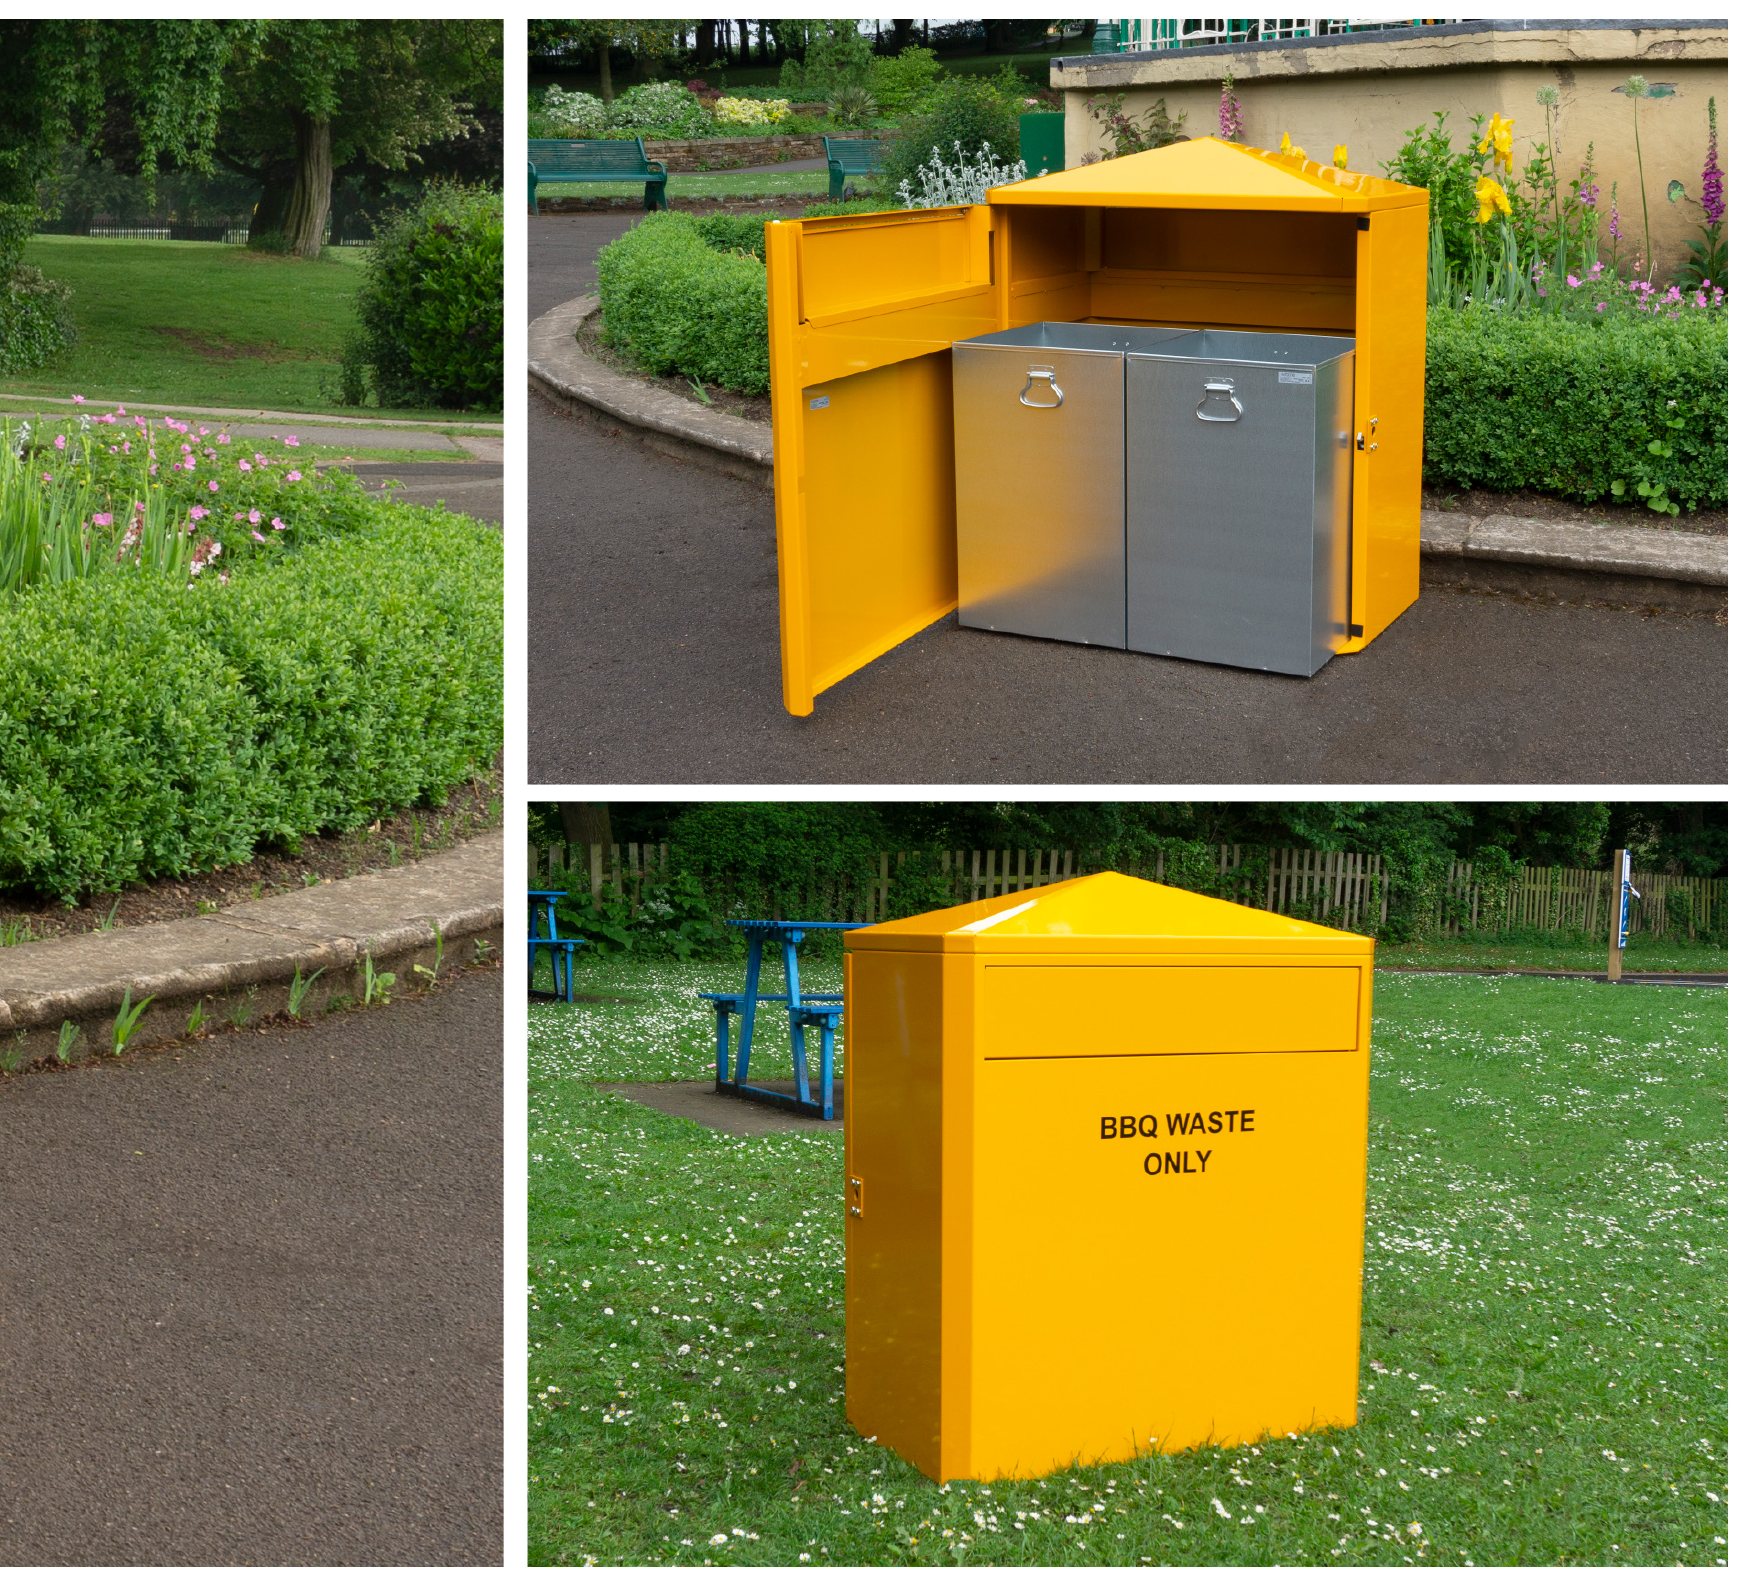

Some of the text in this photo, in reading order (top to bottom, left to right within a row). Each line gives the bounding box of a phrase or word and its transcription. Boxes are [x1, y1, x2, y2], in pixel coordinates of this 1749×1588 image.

[1100, 1109, 1255, 1140] BBQ WASTE
[1143, 1150, 1212, 1176] ONLY
